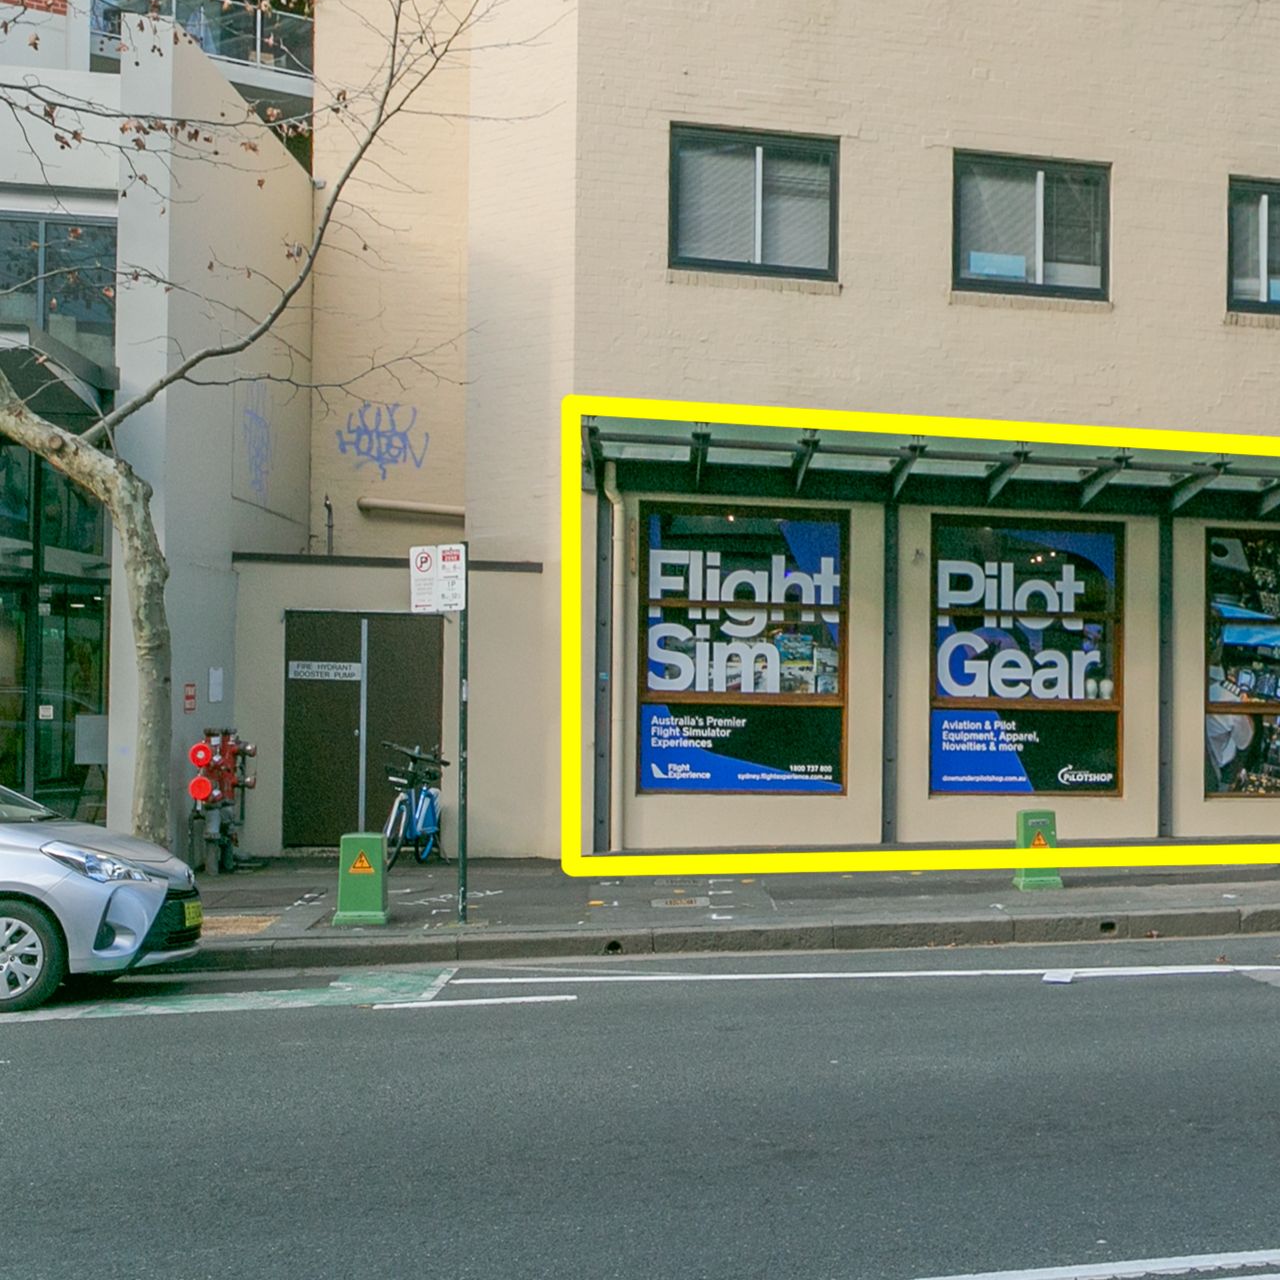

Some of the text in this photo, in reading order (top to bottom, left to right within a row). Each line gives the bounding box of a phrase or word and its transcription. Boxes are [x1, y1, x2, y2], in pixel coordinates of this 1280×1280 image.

[648, 549, 840, 638] Flight
[937, 559, 1085, 631] Pilot
[647, 623, 780, 693] Sim
[937, 631, 1101, 699] Gear
[650, 716, 747, 727] Australia's Premier
[942, 720, 1016, 730] Aviation & Pilot
[651, 727, 731, 738] Flight Simulator
[942, 731, 1040, 743] Equipment, Apparel,
[651, 738, 713, 749] Experiences
[942, 742, 1024, 752] Novelties & more
[668, 763, 690, 772] Flight
[668, 771, 711, 780] Experience
